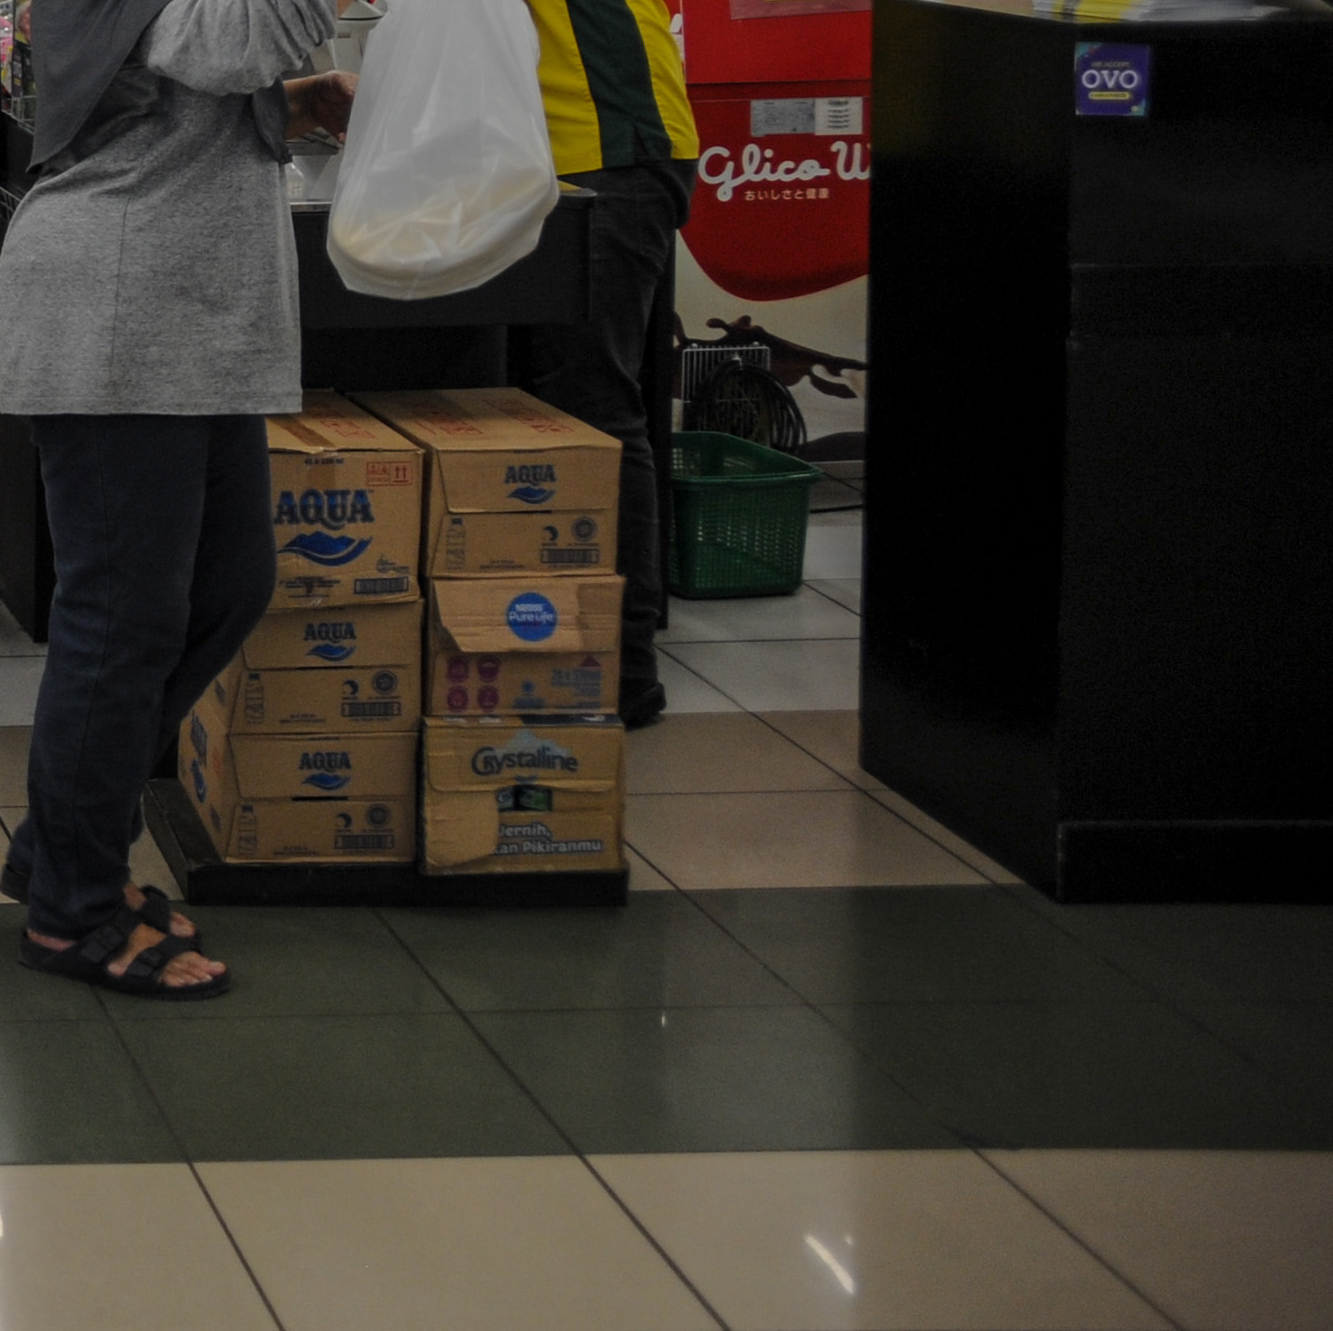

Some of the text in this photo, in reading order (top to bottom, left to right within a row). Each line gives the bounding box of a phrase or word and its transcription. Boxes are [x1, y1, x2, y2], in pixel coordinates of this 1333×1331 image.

[1082, 70, 1138, 88] OVO
[699, 145, 830, 203] Glico
[744, 188, 830, 201] おいしさと健康
[504, 464, 557, 487] AQUA
[273, 490, 375, 530] AQUA
[304, 622, 357, 644] AQUA
[298, 751, 352, 773] AQUA
[471, 745, 579, 777] Crystalline
[522, 839, 602, 855] Pikiranmu
